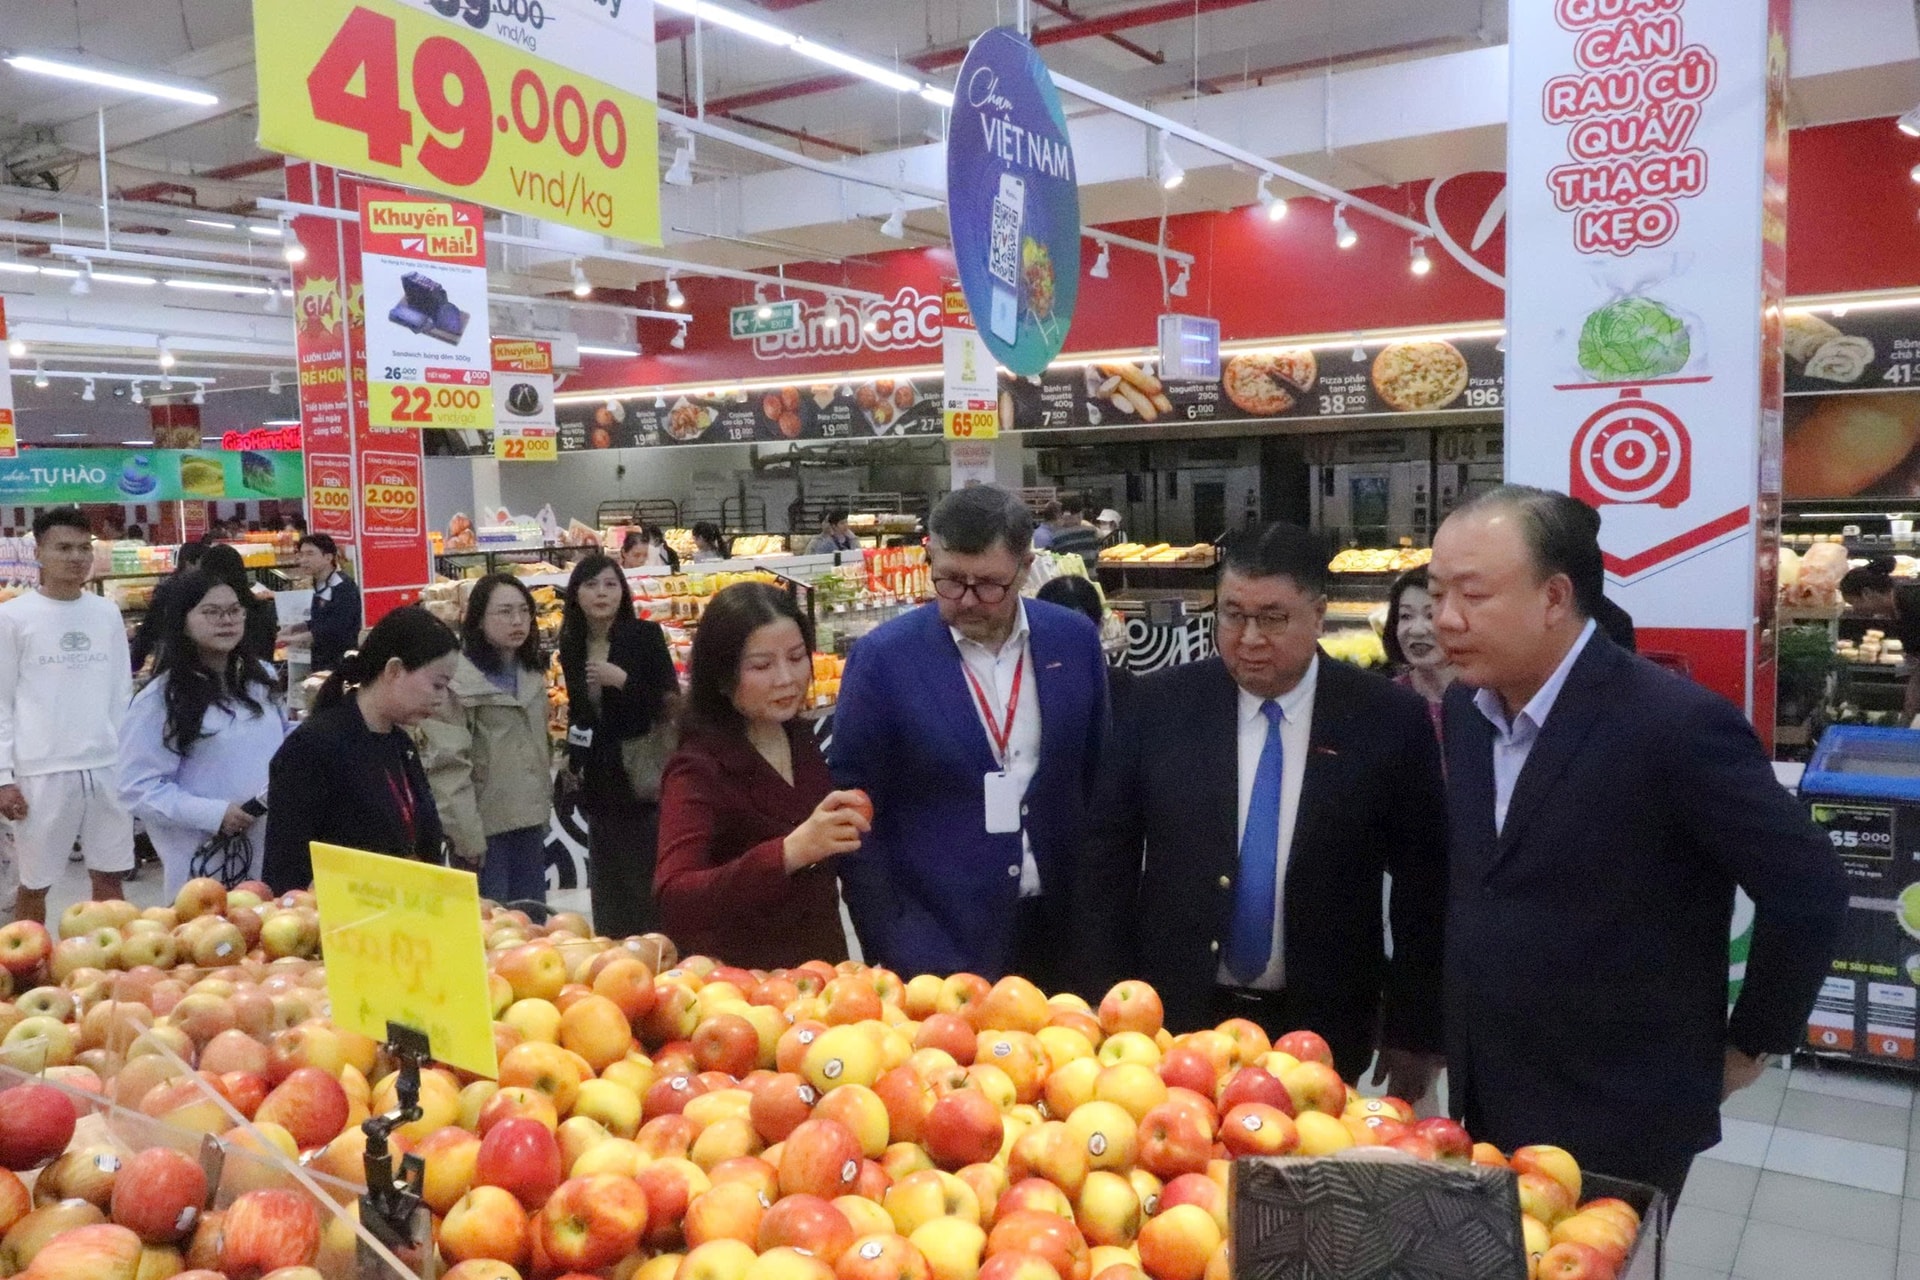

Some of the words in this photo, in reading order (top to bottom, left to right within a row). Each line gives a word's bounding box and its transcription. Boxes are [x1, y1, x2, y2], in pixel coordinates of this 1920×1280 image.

[496, 22, 537, 51] vnd/kg
[1586, 22, 1672, 63] CÂN
[307, 5, 627, 187] 49.000
[1553, 76, 1634, 114] RAU
[1648, 56, 1705, 98] CỦ
[980, 113, 1024, 169] VIỆT
[1028, 131, 1070, 180] NAM
[1557, 159, 1696, 203] THẠCH
[510, 166, 614, 228] vnd/kg
[373, 207, 449, 230] Khuyến
[1584, 209, 1667, 247] KẸO
[1320, 376, 1343, 385] Pizza
[1329, 385, 1346, 393] tam
[1469, 377, 1494, 387] Pizza
[391, 385, 480, 422] 22.000
[1319, 394, 1366, 414] 38.000
[952, 412, 994, 437] 65.000
[504, 439, 549, 458] 22.000
[29, 468, 60, 487] TỰ
[62, 465, 107, 483] HÀO
[314, 490, 349, 507] 2.000
[367, 488, 416, 505] 2.000
